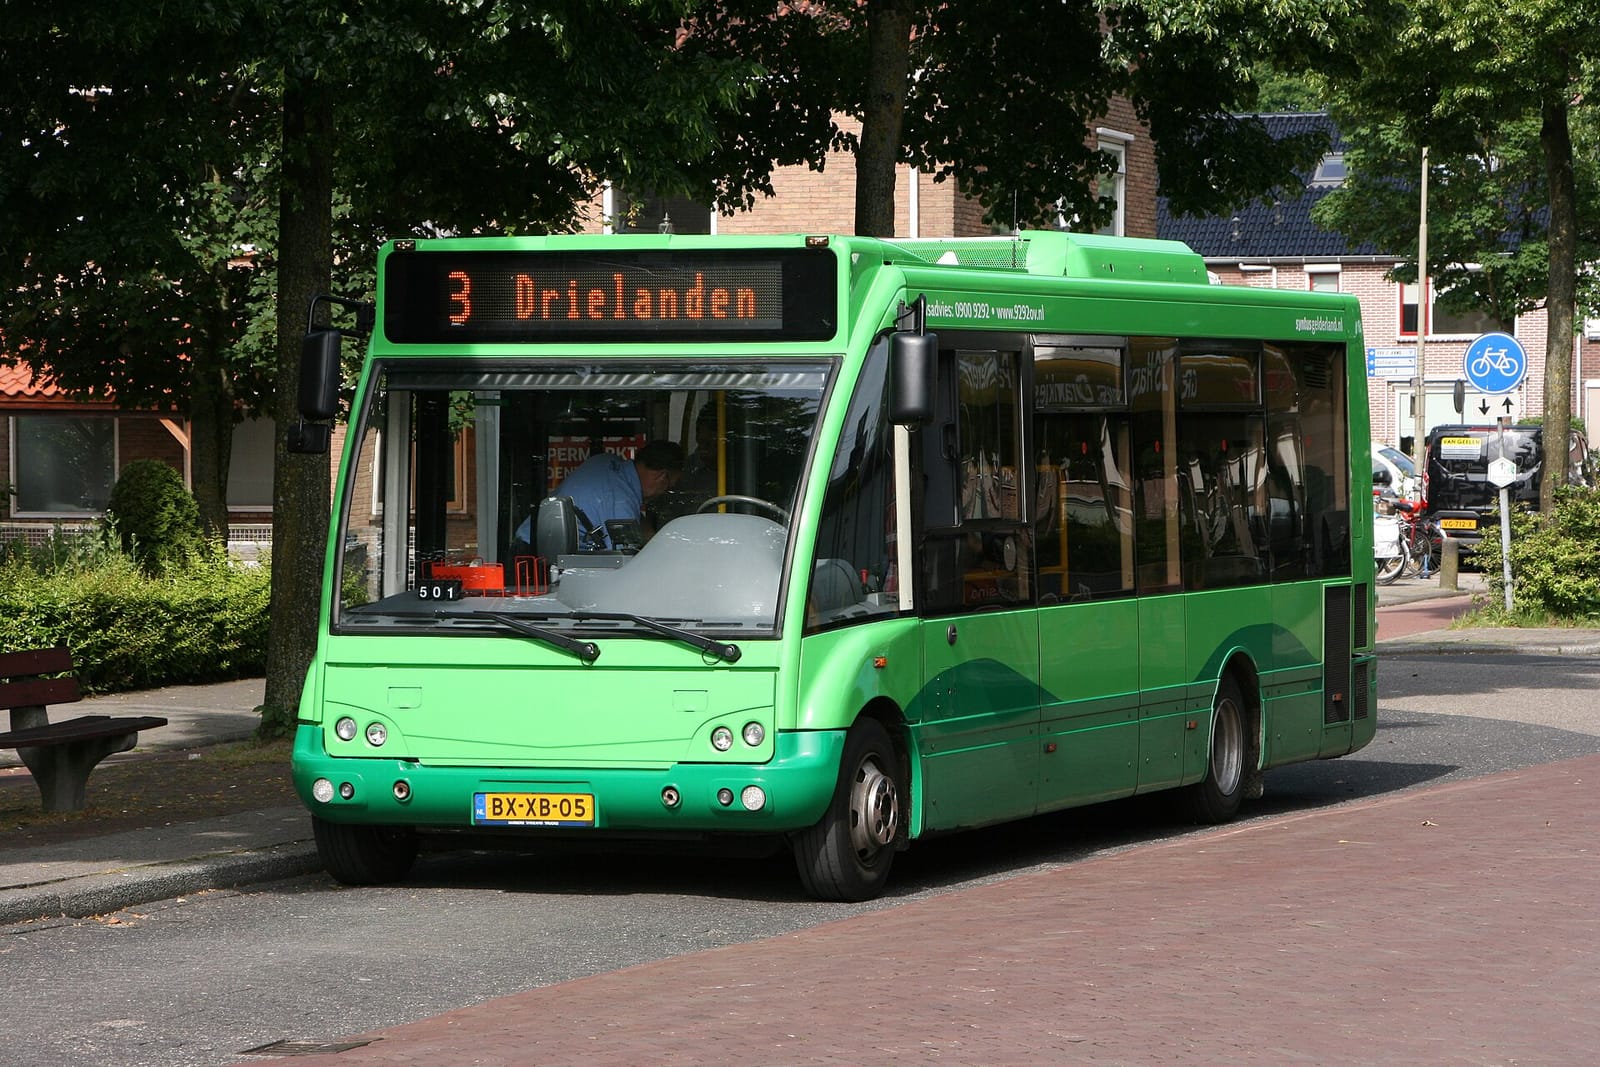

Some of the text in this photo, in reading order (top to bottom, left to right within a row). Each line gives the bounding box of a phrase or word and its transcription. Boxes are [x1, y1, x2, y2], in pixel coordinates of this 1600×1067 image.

[448, 271, 756, 323] 3 Drielanden
[954, 302, 972, 318] 0900
[973, 303, 990, 318] 9292
[491, 797, 586, 817] BX-XB-05
